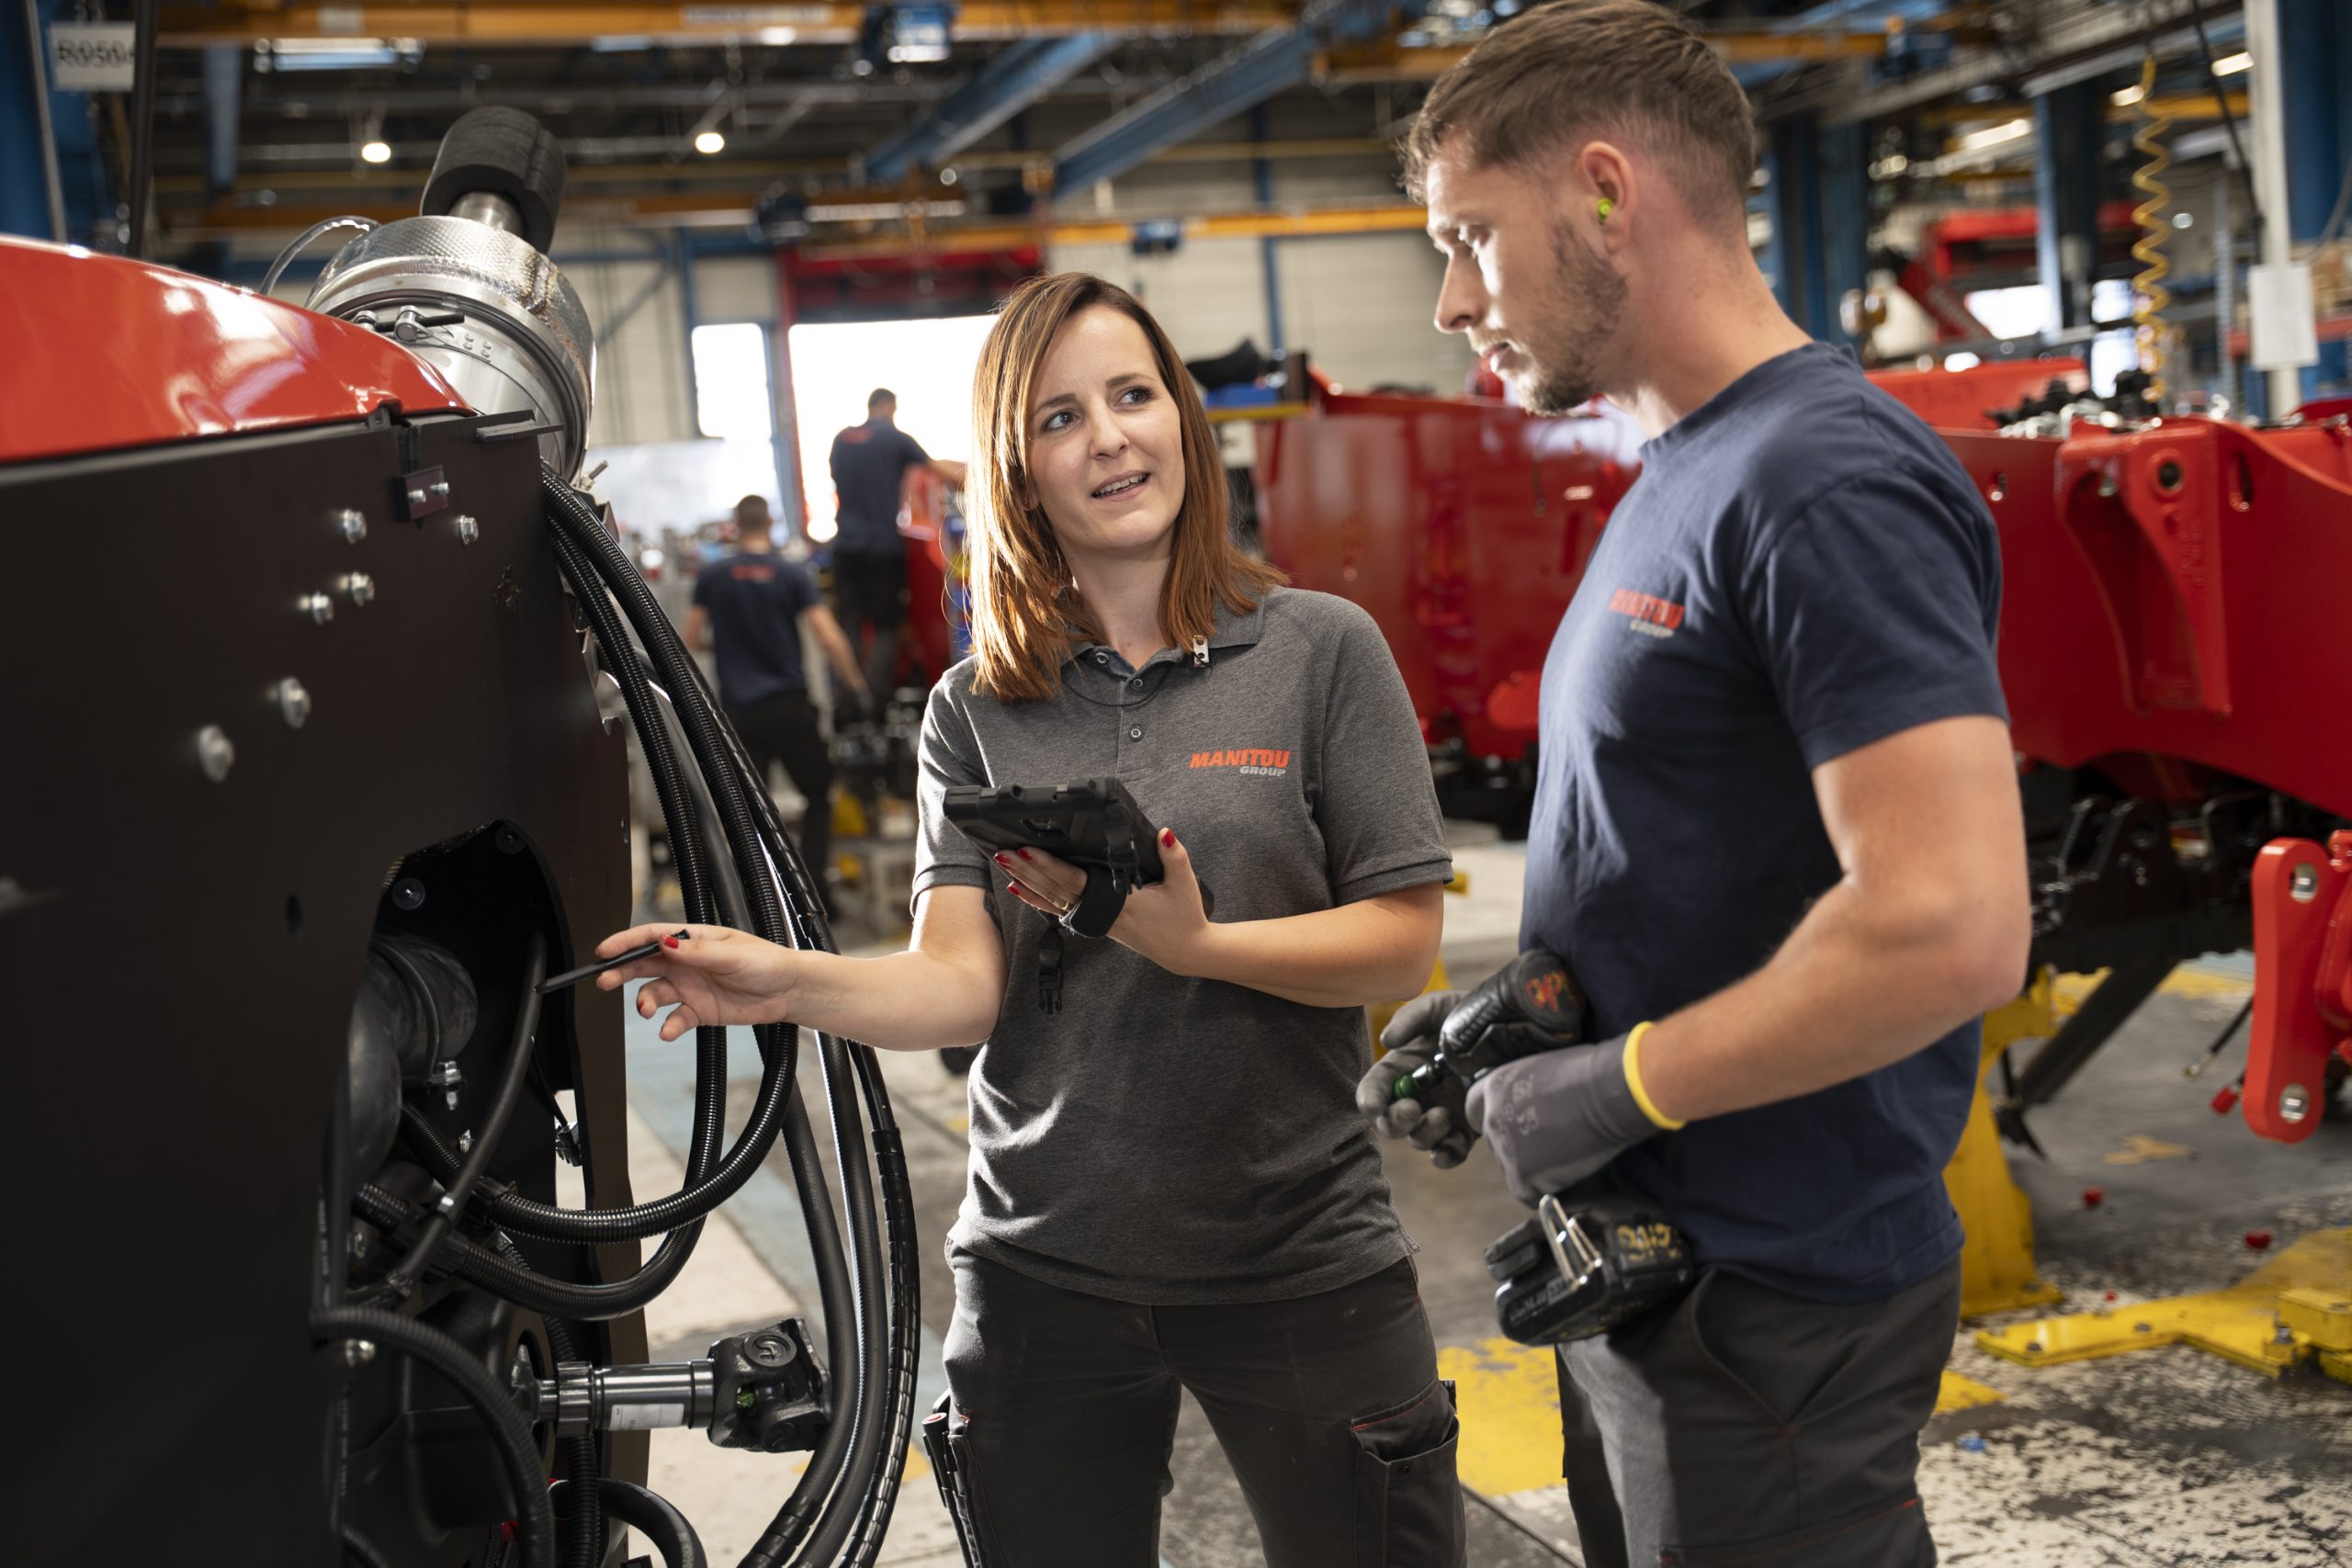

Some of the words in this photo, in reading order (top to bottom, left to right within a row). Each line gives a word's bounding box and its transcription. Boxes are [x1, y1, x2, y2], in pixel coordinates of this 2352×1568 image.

[1608, 588, 1686, 630] MANITOU
[1190, 749, 1290, 768] MANITOU
[1239, 766, 1286, 776] GROUP
